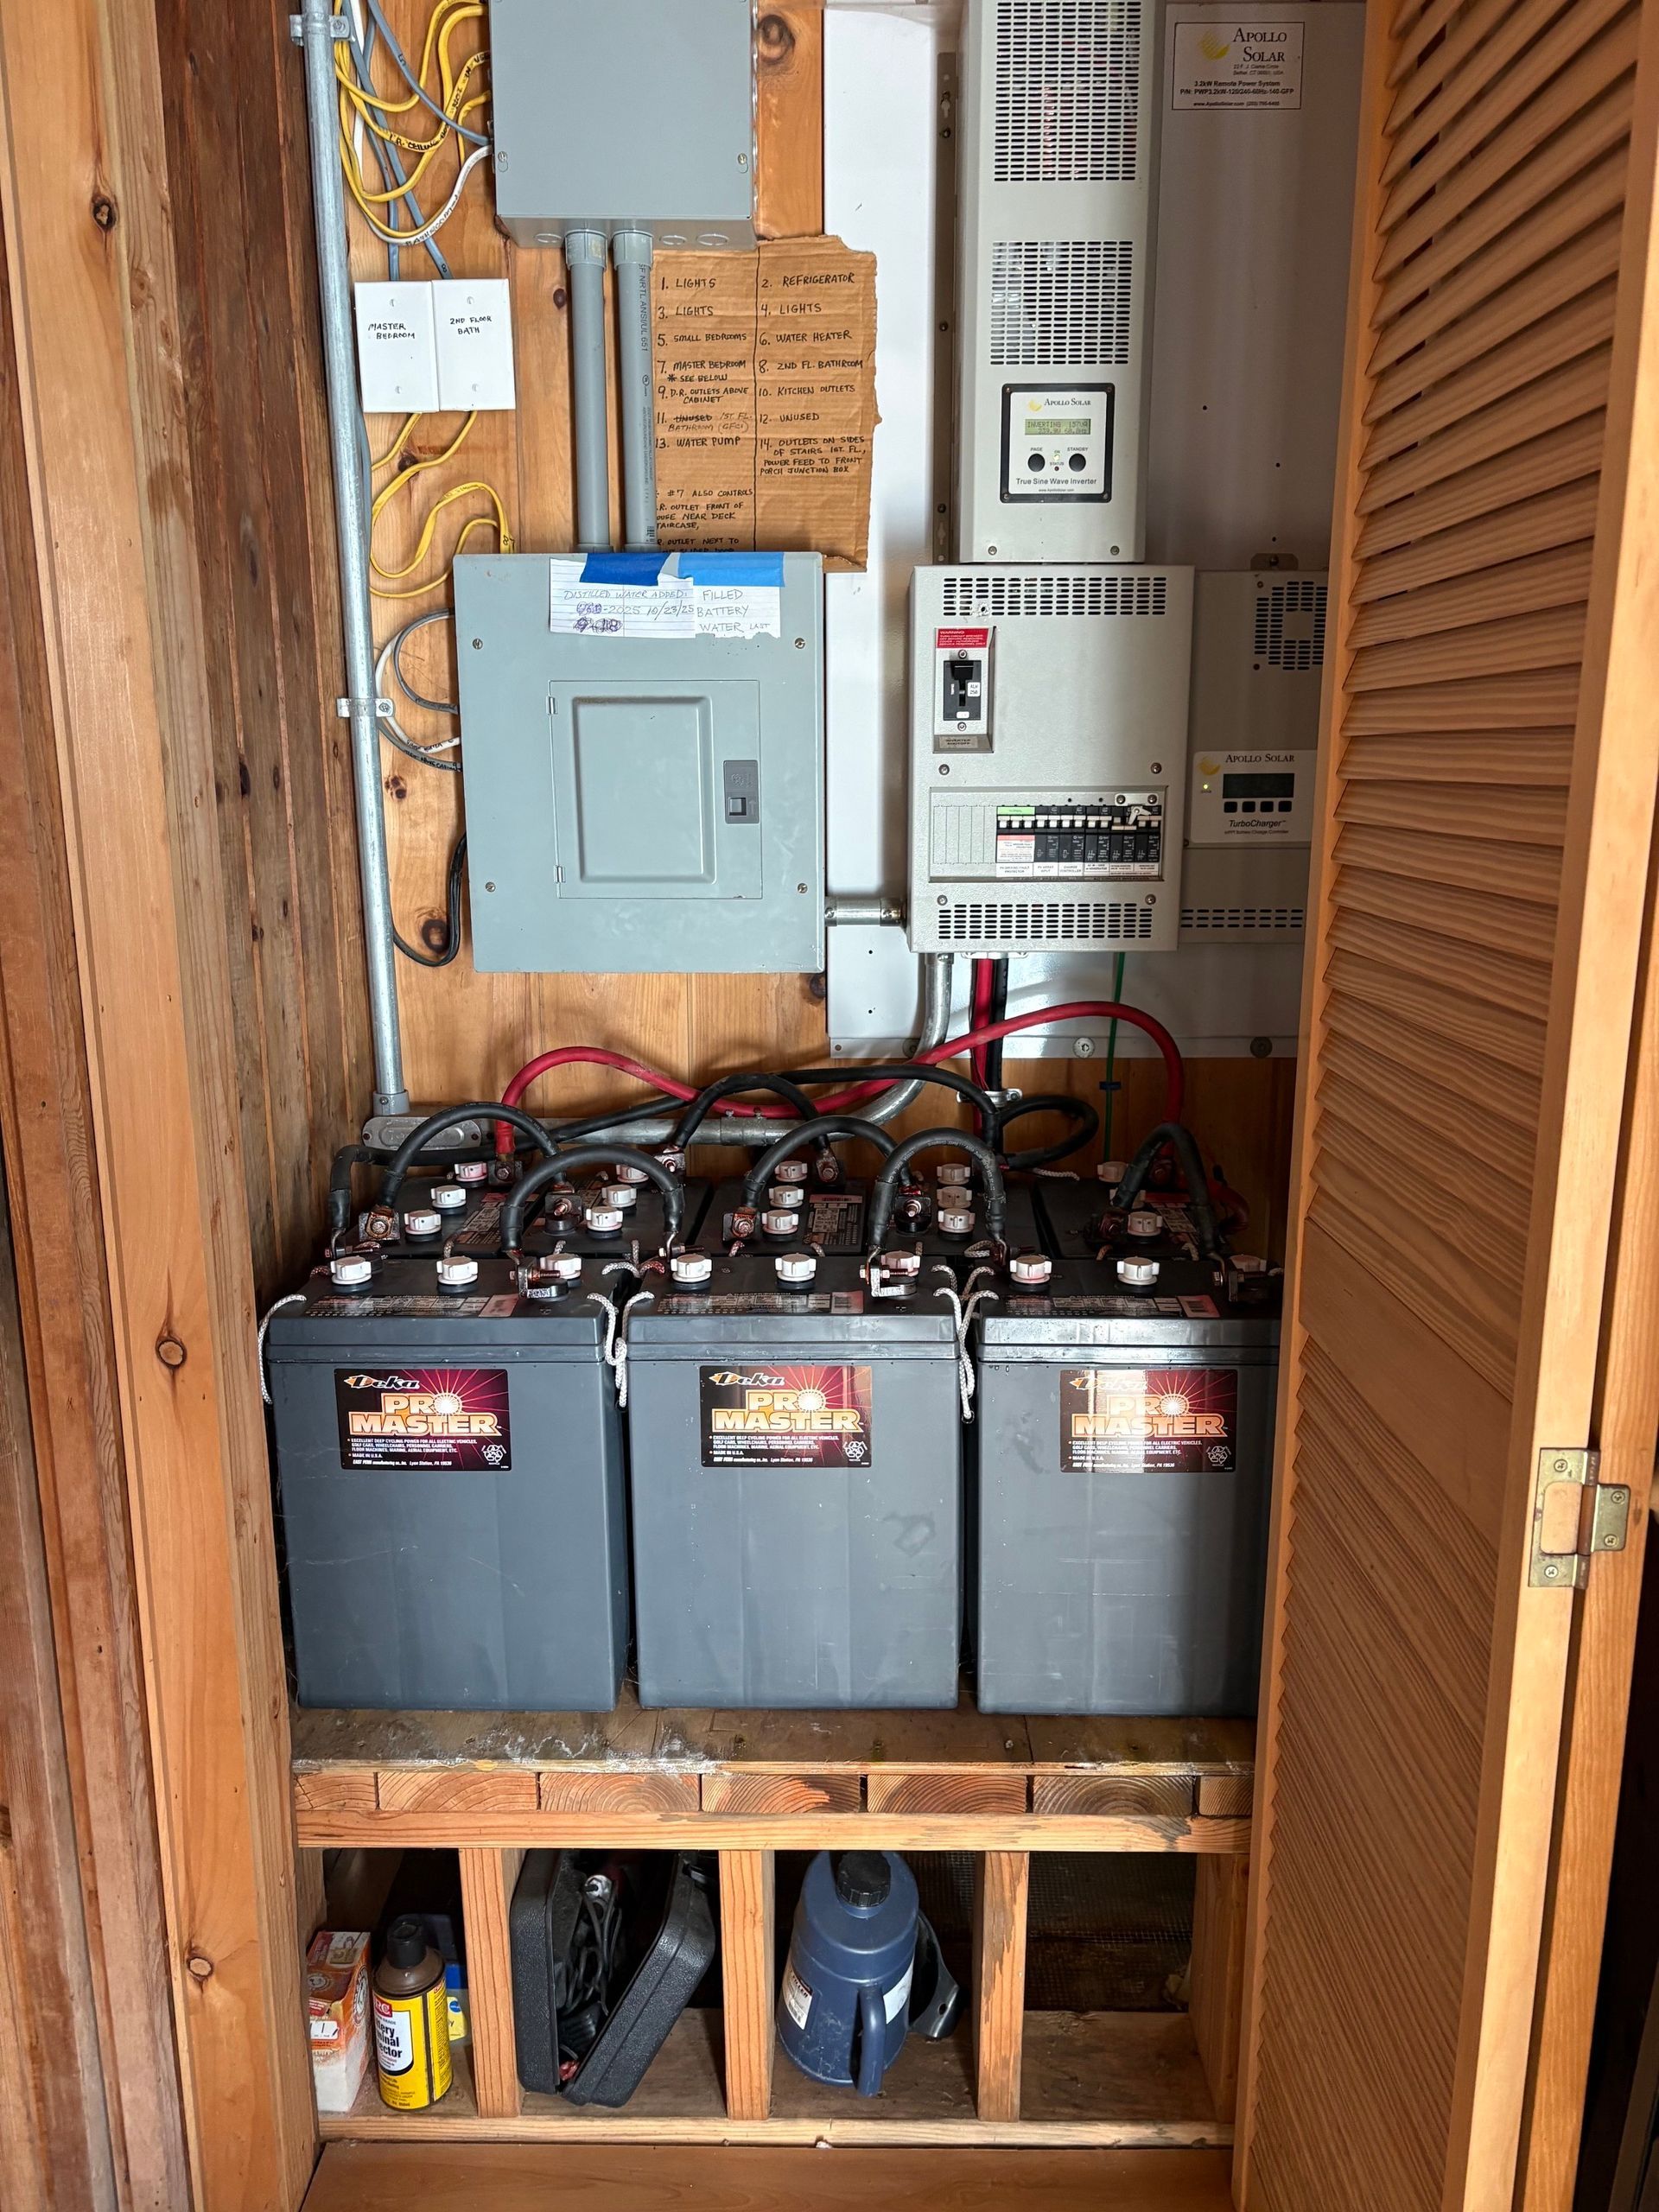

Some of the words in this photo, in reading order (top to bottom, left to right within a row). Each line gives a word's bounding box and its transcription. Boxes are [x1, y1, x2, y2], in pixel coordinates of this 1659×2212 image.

[1233, 28, 1287, 42] APOLLO
[1243, 47, 1285, 61] SOLAR
[661, 276, 669, 289] 1.
[676, 278, 716, 288] LIGHTS
[761, 279, 772, 288] 2.
[783, 272, 855, 287] REFRIGERATOR
[658, 306, 668, 320] 3.
[676, 306, 714, 315] LIGHTS
[779, 303, 821, 314] LIGHTS
[658, 334, 668, 346] 5.
[760, 333, 770, 346] 6.
[777, 333, 807, 342] WATER
[813, 330, 852, 340] HEATER
[658, 361, 667, 373] 7.
[673, 360, 705, 371] MASTER
[709, 360, 746, 369] BEDROOM
[760, 359, 769, 372] 8.
[818, 359, 862, 369] BATHROOM
[658, 386, 668, 399] 9.
[759, 388, 772, 397] 10.
[778, 386, 814, 396] KITCHEN
[658, 412, 666, 423] 11.
[760, 414, 772, 423] 12.
[779, 413, 819, 422] UNUSED
[656, 438, 669, 448] 13.
[677, 438, 708, 448] WATER
[712, 436, 741, 446] PUMP
[760, 439, 772, 450] 14.
[779, 438, 818, 447] OUTLETS
[760, 467, 783, 476] PORCH
[667, 489, 684, 498] #7
[564, 591, 610, 600] DISTILLED
[702, 589, 743, 601] FILLED
[697, 605, 749, 617] BATTERY
[700, 622, 744, 632] WATER
[1226, 754, 1262, 763] APOLLO
[1265, 753, 1294, 762] SOLAR
[353, 1376, 419, 1389] Deka
[717, 1372, 785, 1387] Deka
[382, 1393, 462, 1416] PRO
[747, 1389, 826, 1413] PRO
[1107, 1394, 1189, 1417] PRO
[349, 1411, 502, 1436] MASTER
[712, 1408, 863, 1433] MASTER
[1071, 1414, 1227, 1438] MASTER
